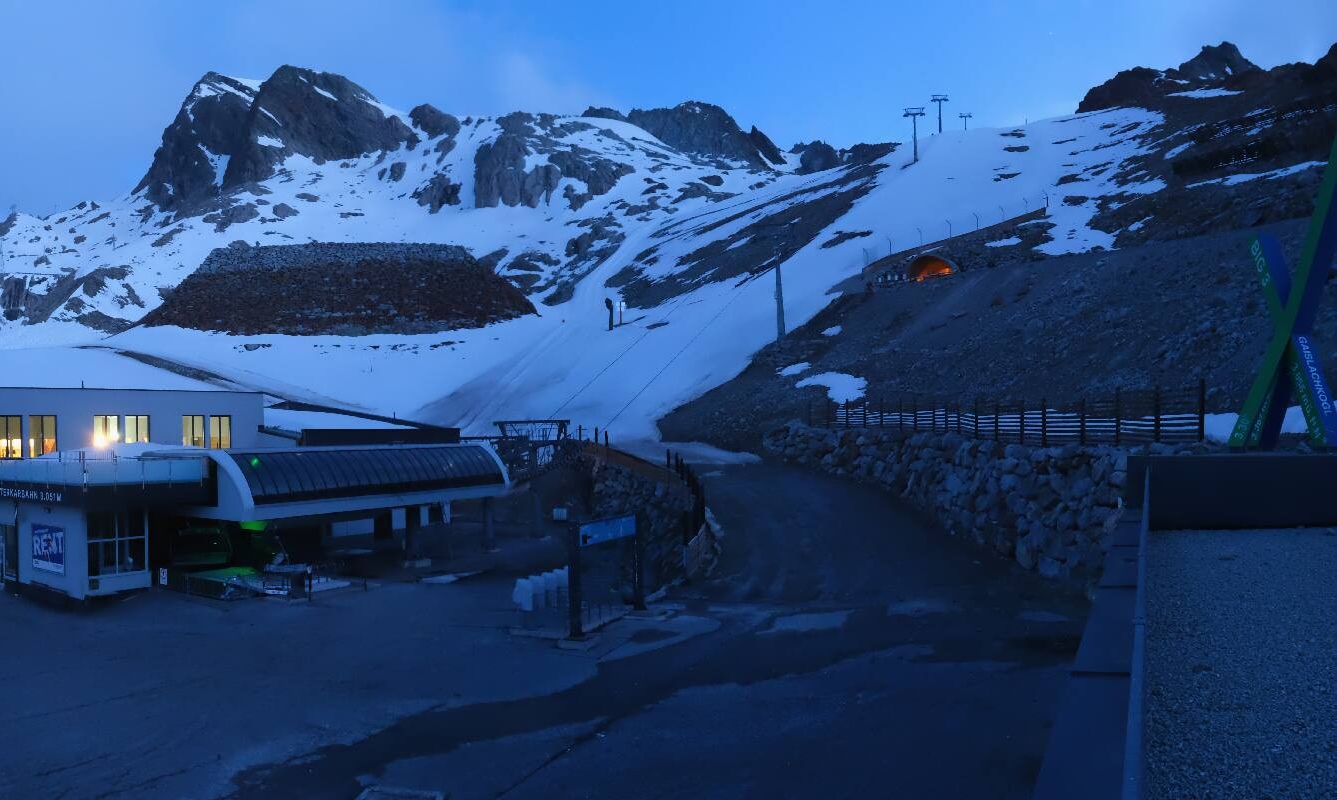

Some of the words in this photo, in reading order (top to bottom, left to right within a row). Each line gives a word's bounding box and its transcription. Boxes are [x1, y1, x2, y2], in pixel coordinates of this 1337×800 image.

[1250, 239, 1266, 273] BIG
[1261, 272, 1271, 287] 3
[32, 532, 64, 556] RENT
